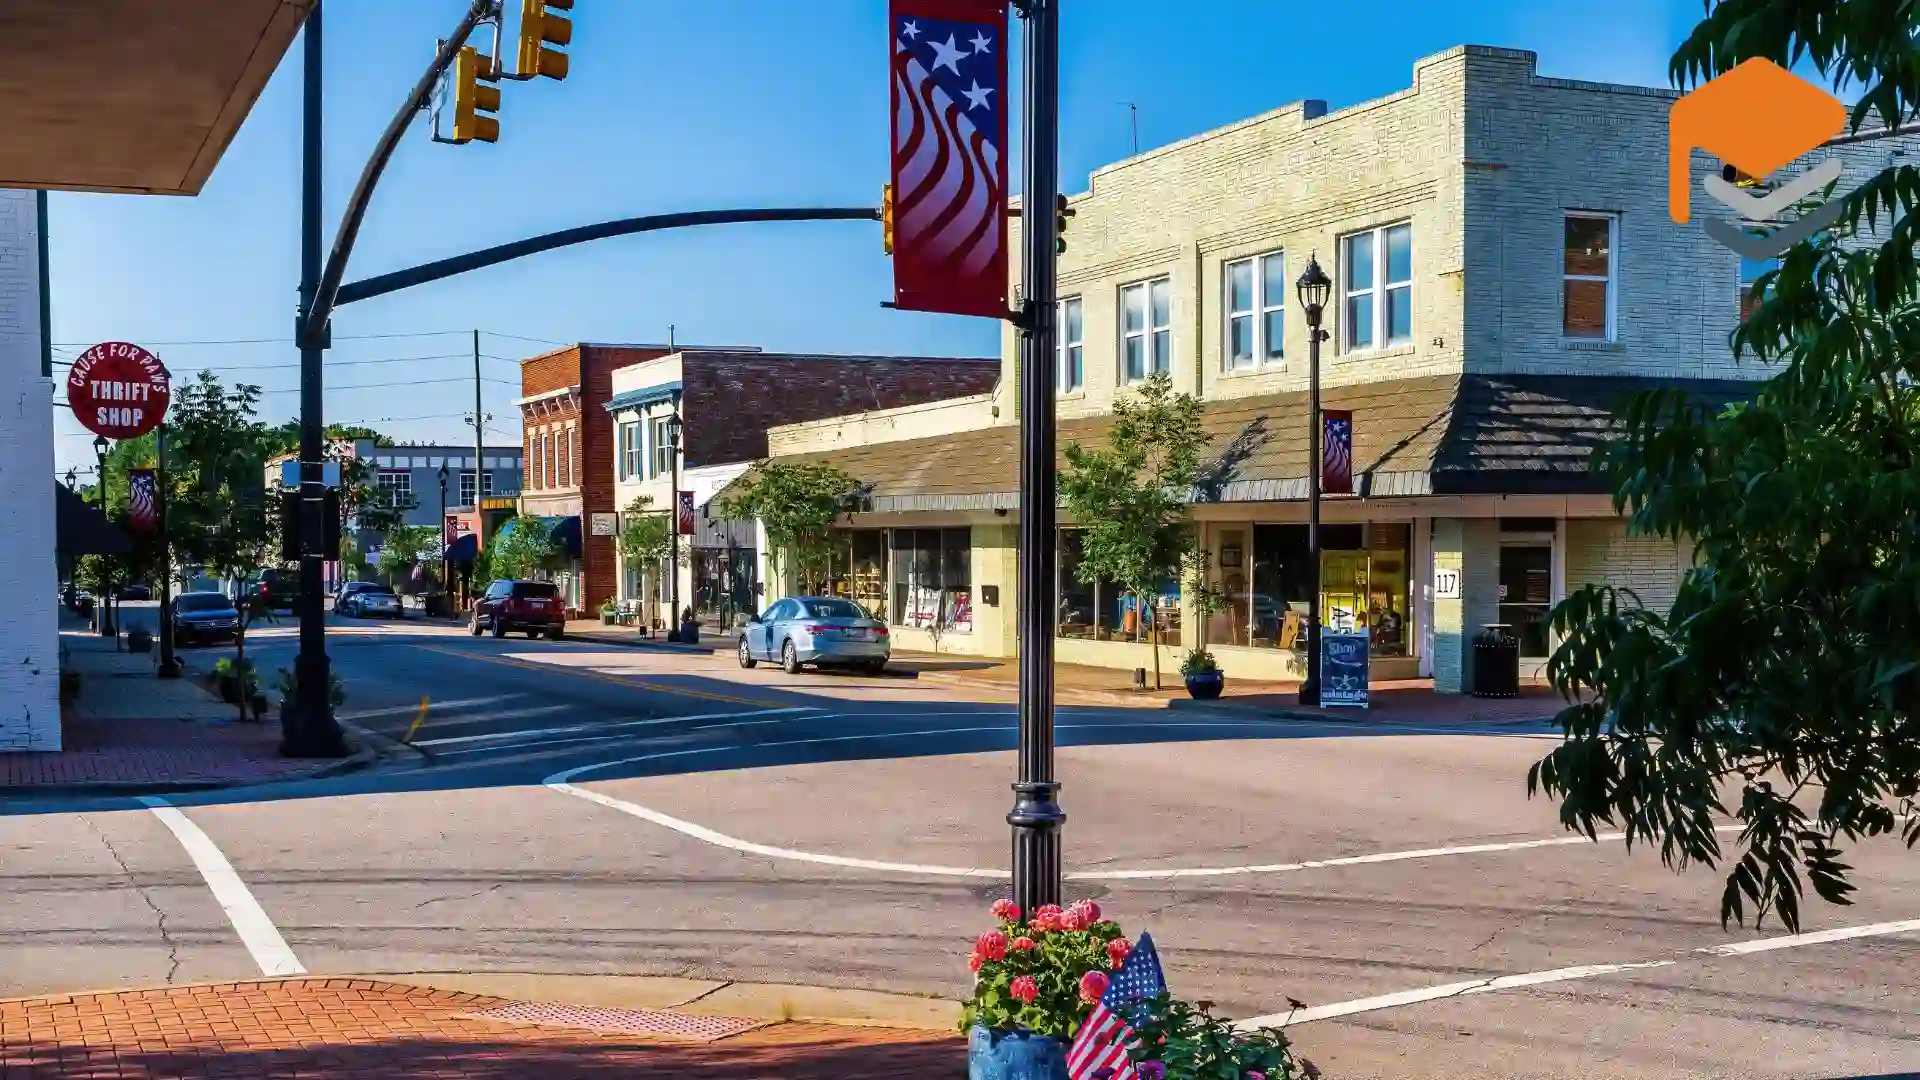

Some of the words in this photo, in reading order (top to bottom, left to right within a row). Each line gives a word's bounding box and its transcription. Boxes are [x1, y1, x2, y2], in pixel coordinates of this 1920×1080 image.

[70, 346, 105, 387] CAUSE
[109, 343, 140, 361] FOR
[140, 355, 167, 393] PAWS
[90, 379, 151, 402] THRIFT
[97, 406, 143, 427] SHOP
[1436, 574, 1456, 593] 117
